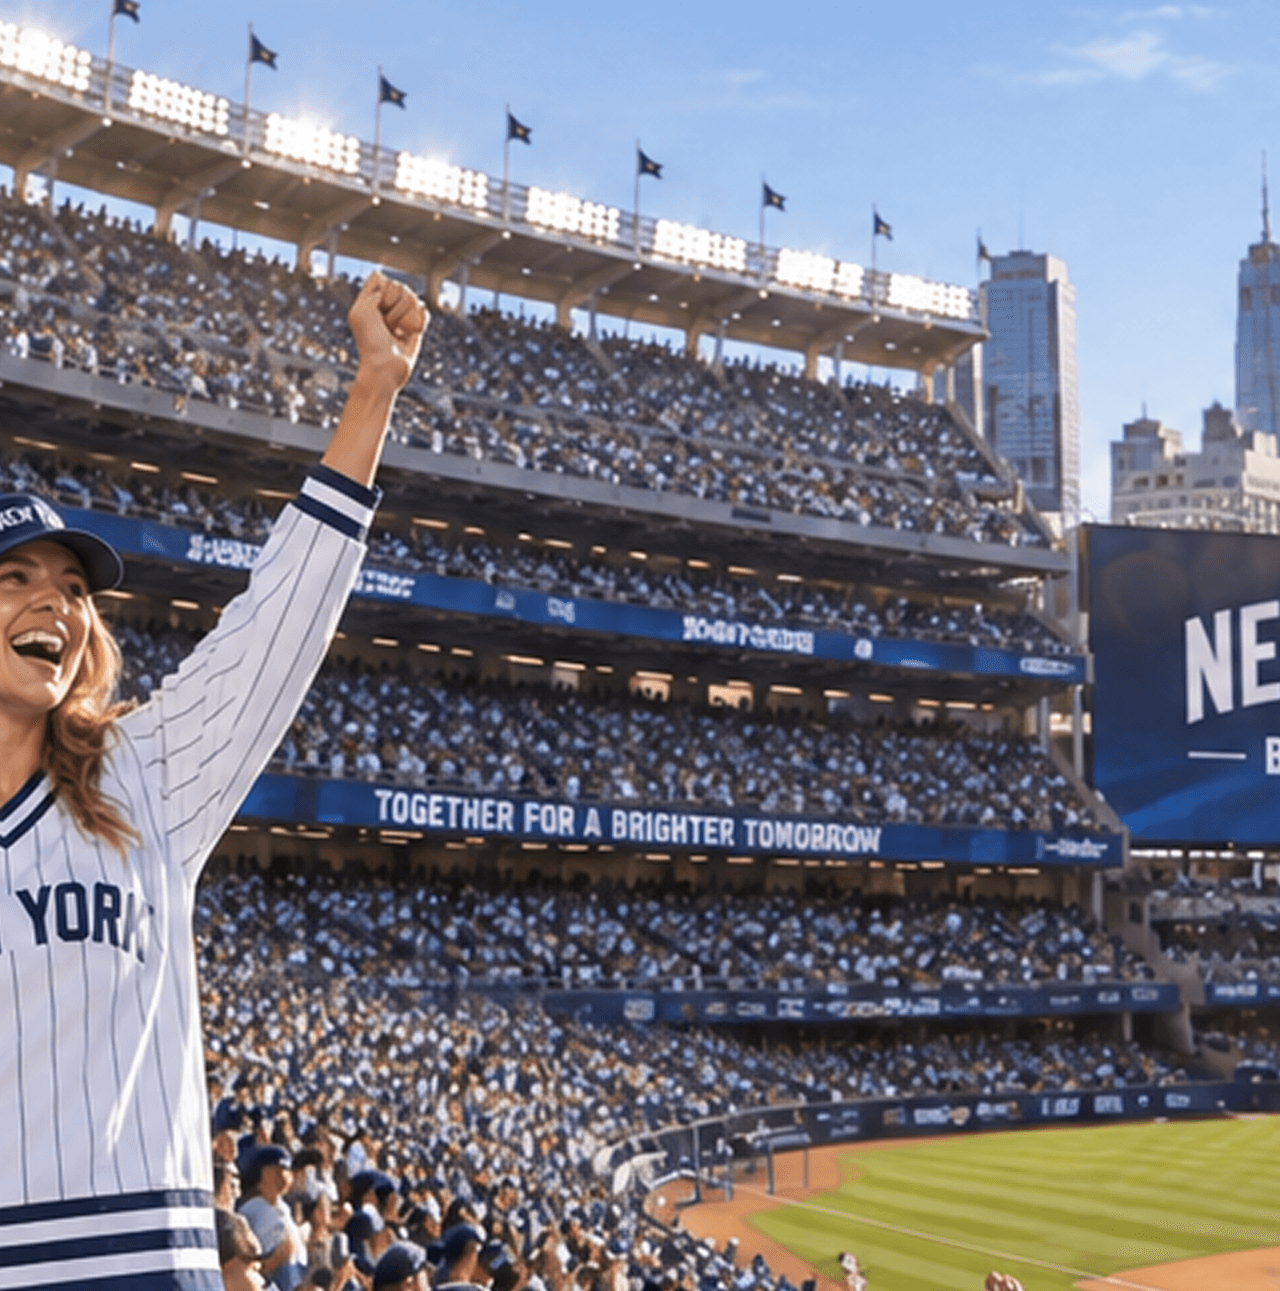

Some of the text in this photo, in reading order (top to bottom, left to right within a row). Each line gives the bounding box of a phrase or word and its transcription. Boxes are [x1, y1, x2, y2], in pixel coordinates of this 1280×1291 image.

[374, 788, 882, 853] TOGETHER FOR A BRIGHTER TOMORROW
